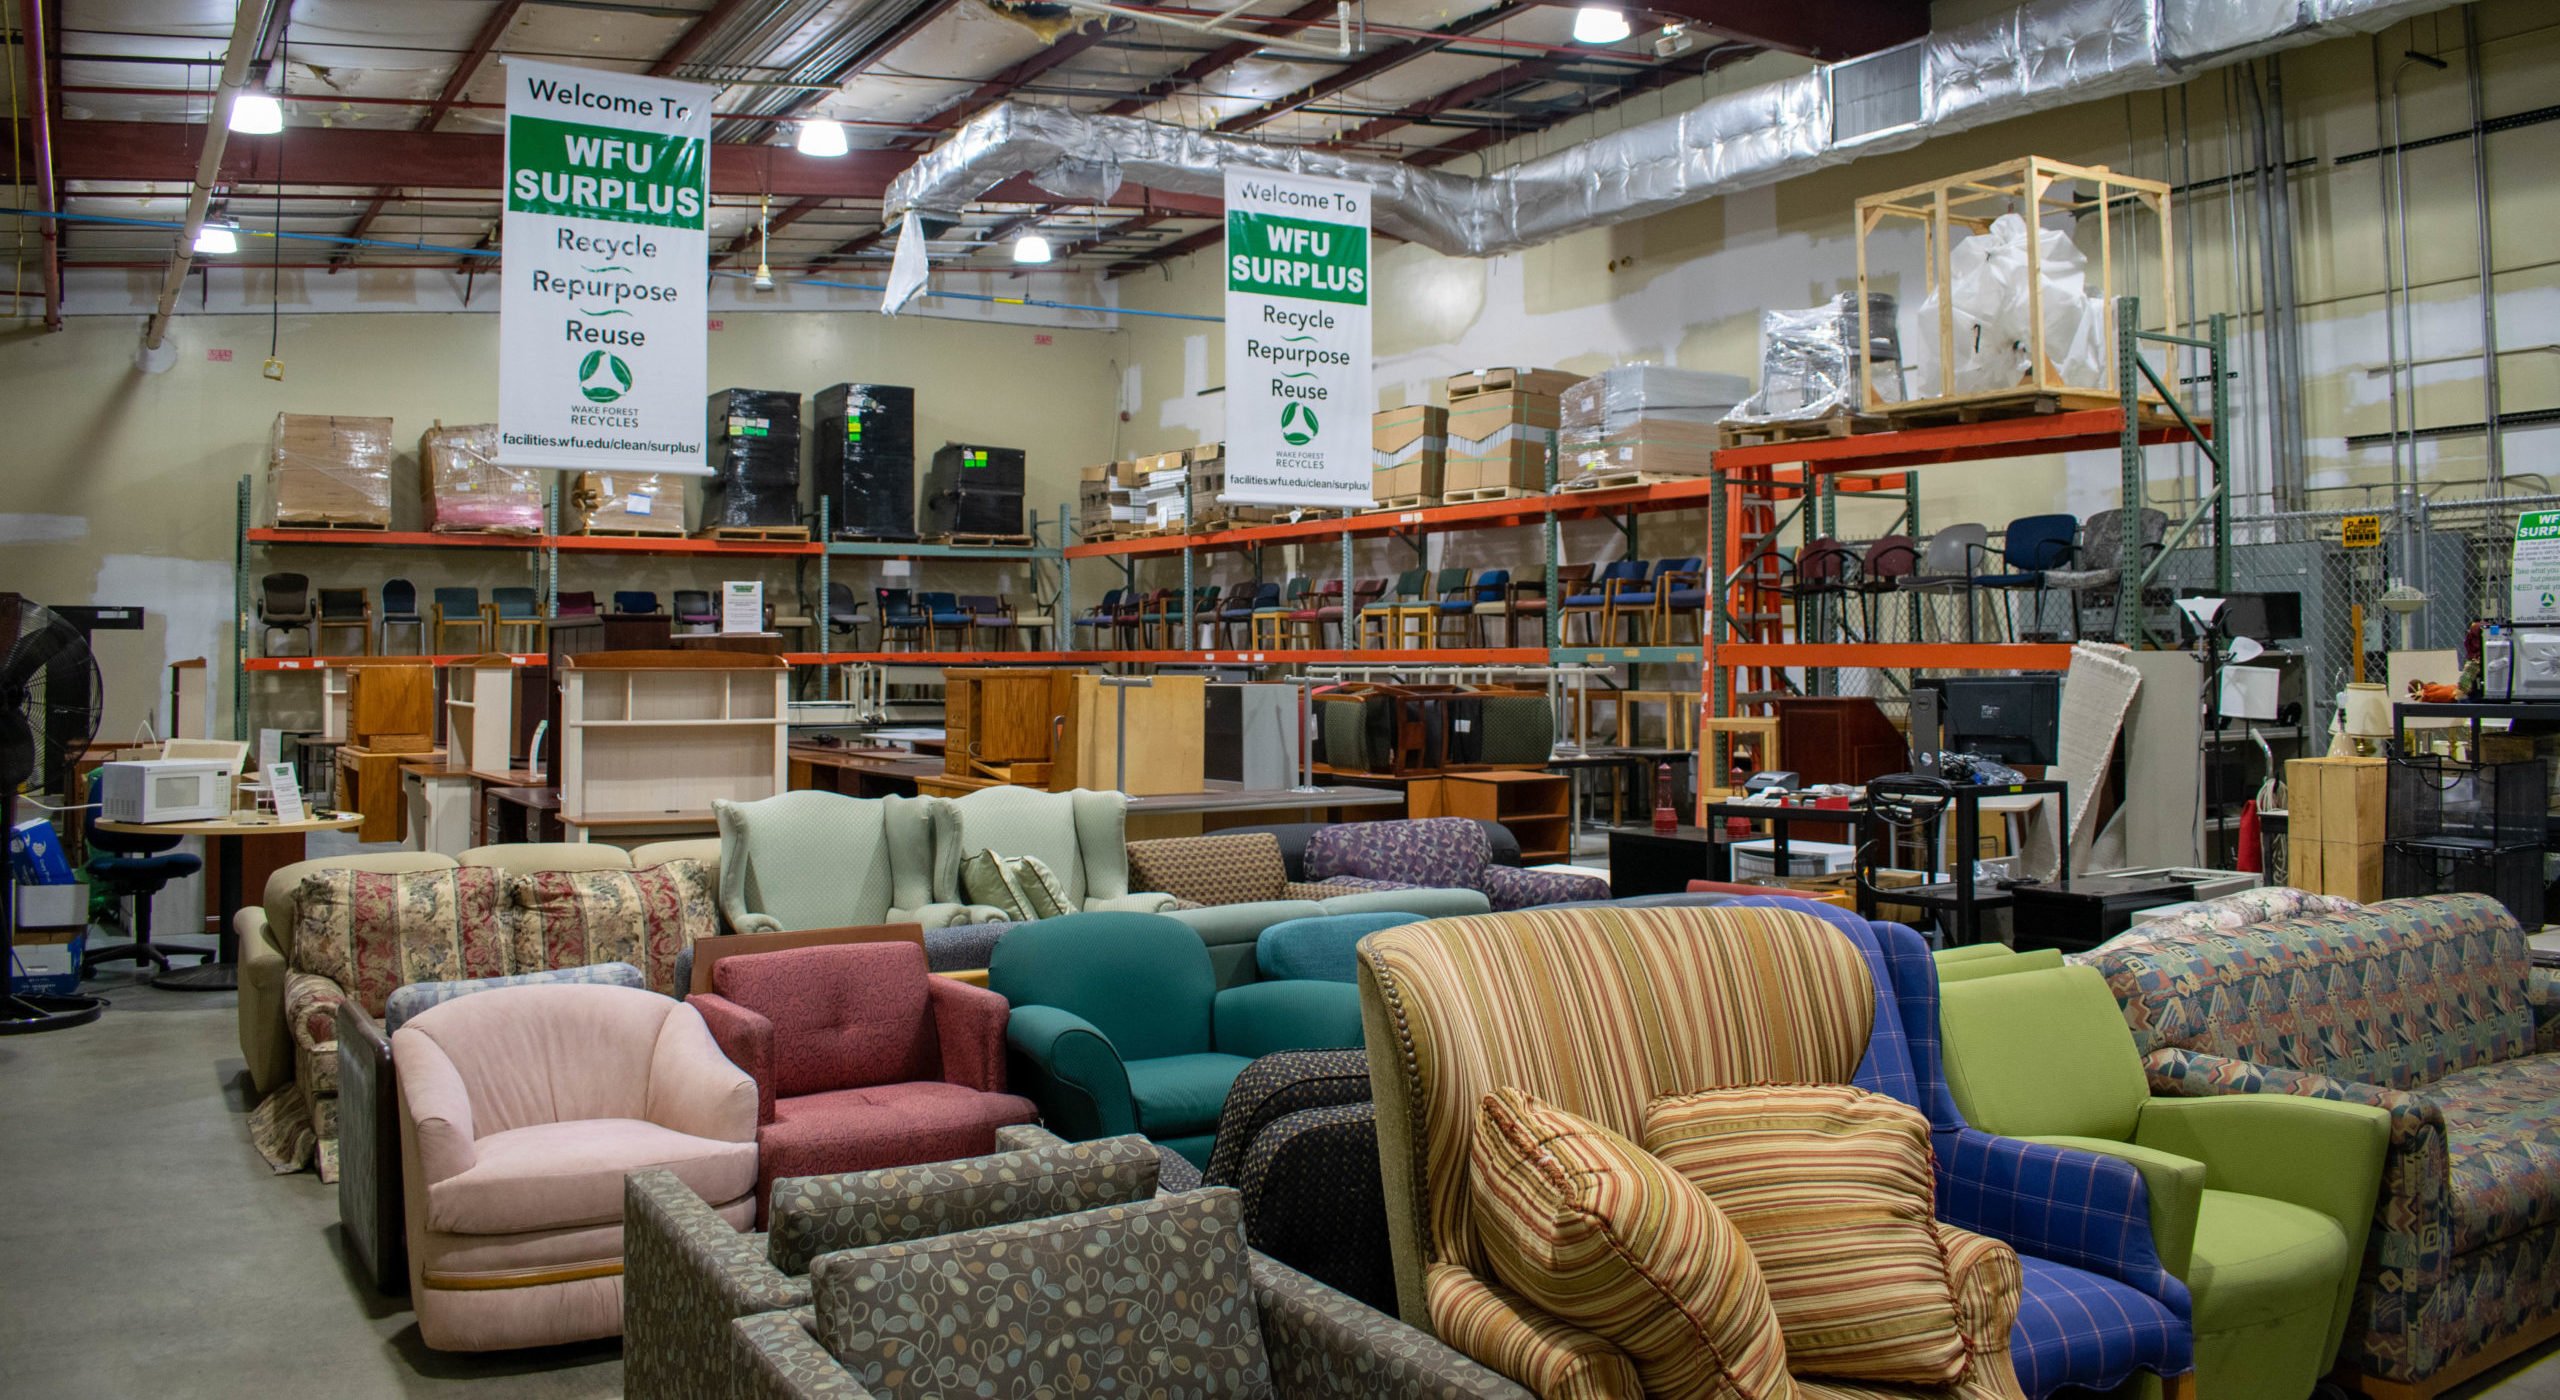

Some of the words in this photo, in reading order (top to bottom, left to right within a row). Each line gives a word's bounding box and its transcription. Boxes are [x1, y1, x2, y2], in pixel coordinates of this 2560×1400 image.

[528, 77, 653, 116] Welcome
[660, 97, 693, 123] To
[564, 134, 652, 174] WFU
[514, 168, 700, 218] SURPLUS
[1241, 181, 1329, 210] Welcome
[1334, 193, 1357, 213] To
[557, 227, 657, 260] Recycle
[1266, 224, 1330, 257] WFU
[532, 270, 678, 304] Repurpose
[1232, 254, 1364, 293] SURPLUS
[1264, 304, 1335, 331] Recycle
[566, 319, 646, 347] Reuse
[1247, 339, 1350, 367] Repurpose
[1271, 378, 1328, 400] Reuse
[571, 405, 600, 415] WAKE
[602, 406, 639, 416] FOREST
[571, 415, 639, 428] RECYCLES
[502, 433, 701, 455] facilities.wfu.edu/clean/surplus/
[1276, 451, 1297, 459] WAKE
[1298, 452, 1324, 460] FOREST
[1276, 459, 1325, 469] RECYCLES
[1230, 474, 1370, 491] facilities.wfu.edu/clean/surplus/
[2519, 525, 2560, 538] SURP
